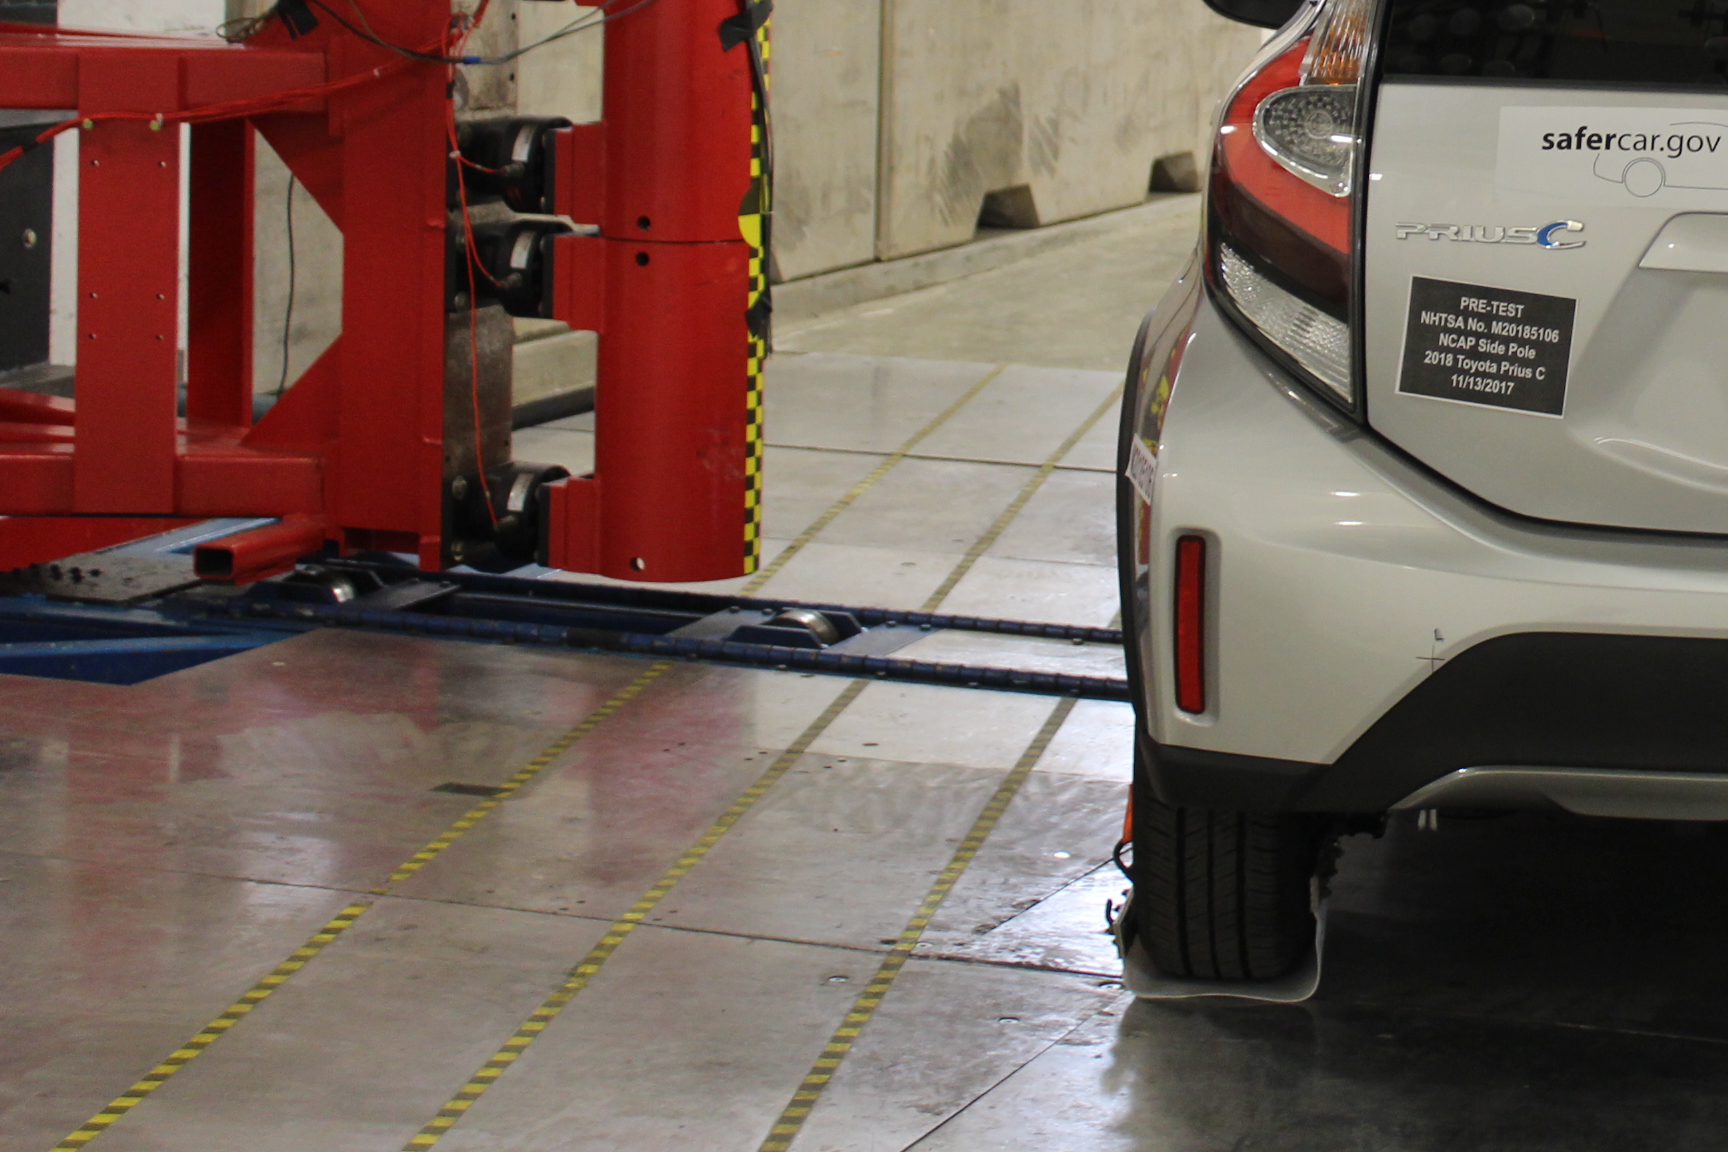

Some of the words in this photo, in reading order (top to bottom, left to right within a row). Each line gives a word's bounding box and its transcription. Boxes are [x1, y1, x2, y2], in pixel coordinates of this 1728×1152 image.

[1541, 125, 1722, 159] safercar.gov
[1395, 222, 1538, 245] PRIUS
[1459, 296, 1525, 318] PRE-TEST
[1420, 310, 1465, 330] NHTSA
[1467, 318, 1488, 333] No.
[1491, 321, 1560, 343] M20185106
[1438, 333, 1476, 350] NCAP
[1477, 338, 1505, 355] Side
[1508, 343, 1537, 360] Pole
[1423, 350, 1454, 367] 2018
[1456, 354, 1498, 374] Toyota
[1500, 361, 1533, 378] Prius
[1535, 366, 1546, 381] C
[1451, 373, 1515, 396] 11/13/2017
